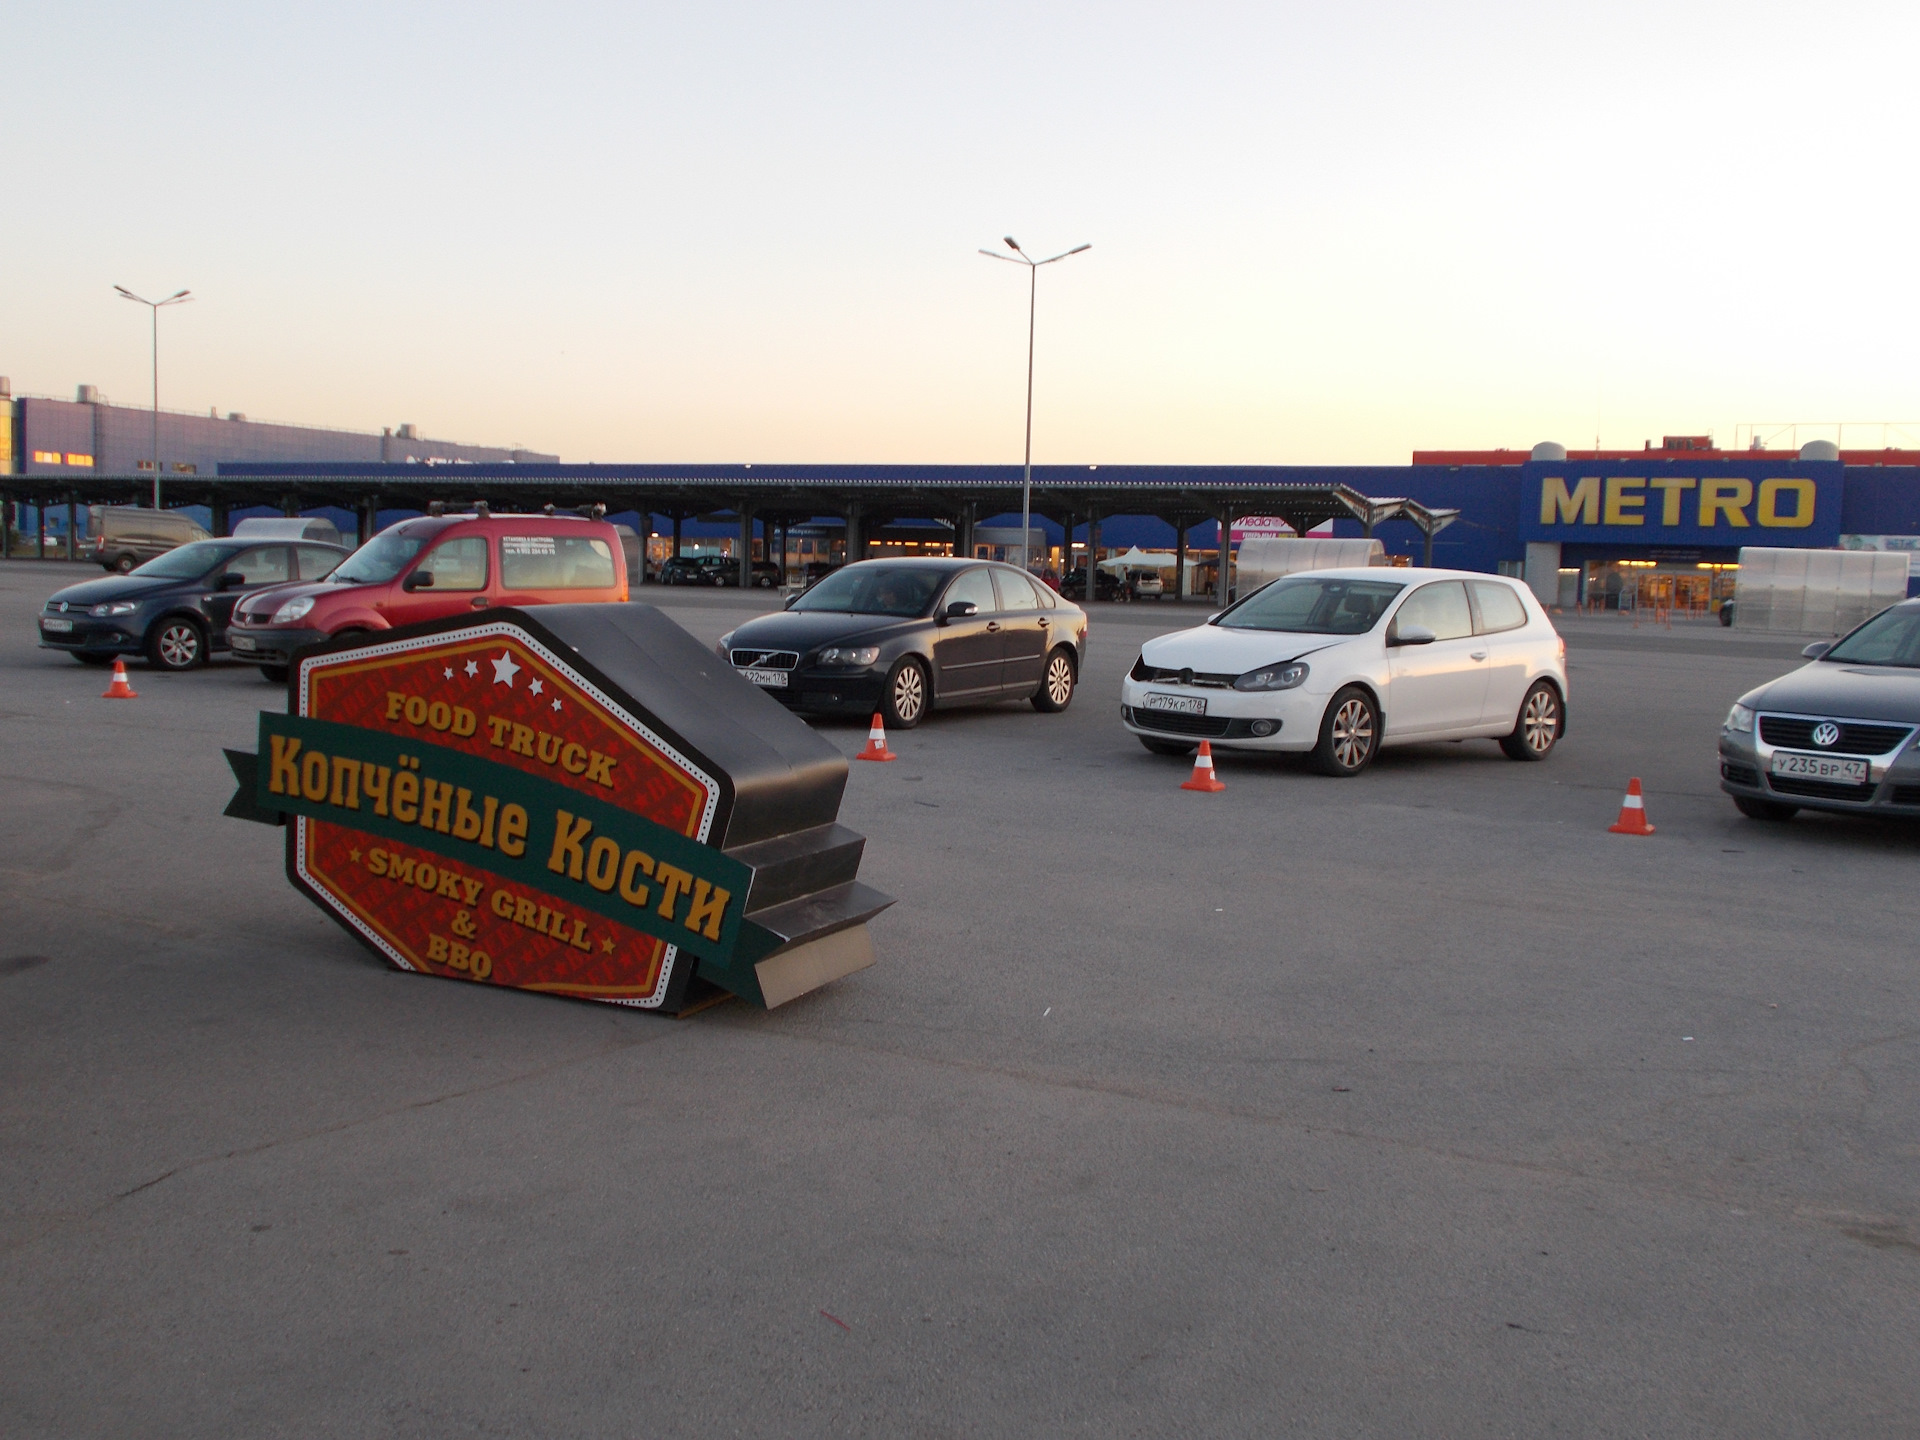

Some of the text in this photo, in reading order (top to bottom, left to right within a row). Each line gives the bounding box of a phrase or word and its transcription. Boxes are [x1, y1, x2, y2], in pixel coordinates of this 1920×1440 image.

[1540, 477, 1816, 528] METRO
[386, 691, 477, 737] FOOD
[488, 716, 618, 788] TRUCK
[1844, 762, 1861, 775] 47
[269, 734, 731, 941] Копчёные Кости
[368, 848, 592, 951] SMOKY GRILL
[451, 910, 475, 939] &
[426, 933, 492, 981] BBQ
